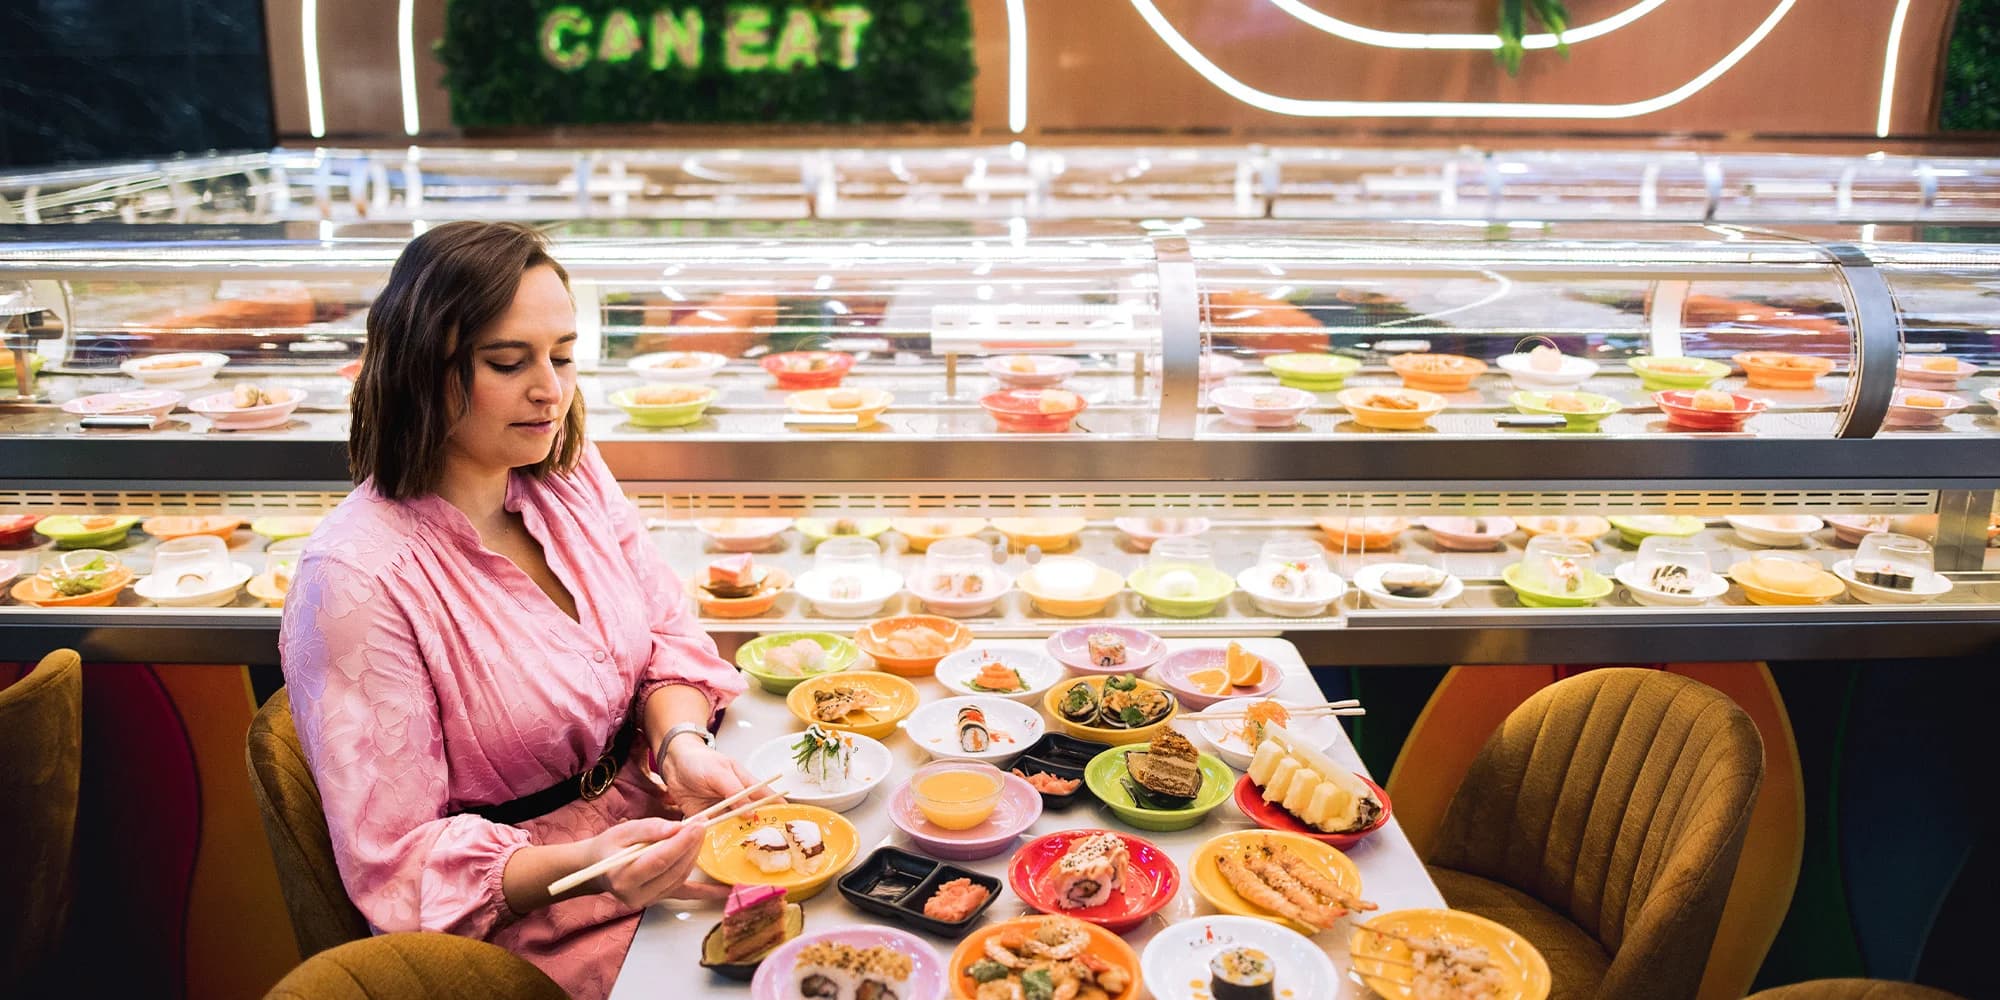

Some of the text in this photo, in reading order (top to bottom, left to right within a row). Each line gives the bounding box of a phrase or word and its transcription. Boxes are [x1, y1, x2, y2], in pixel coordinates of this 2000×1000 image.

[540, 5, 873, 71] CAN EAT
[738, 811, 778, 831] KYTO
